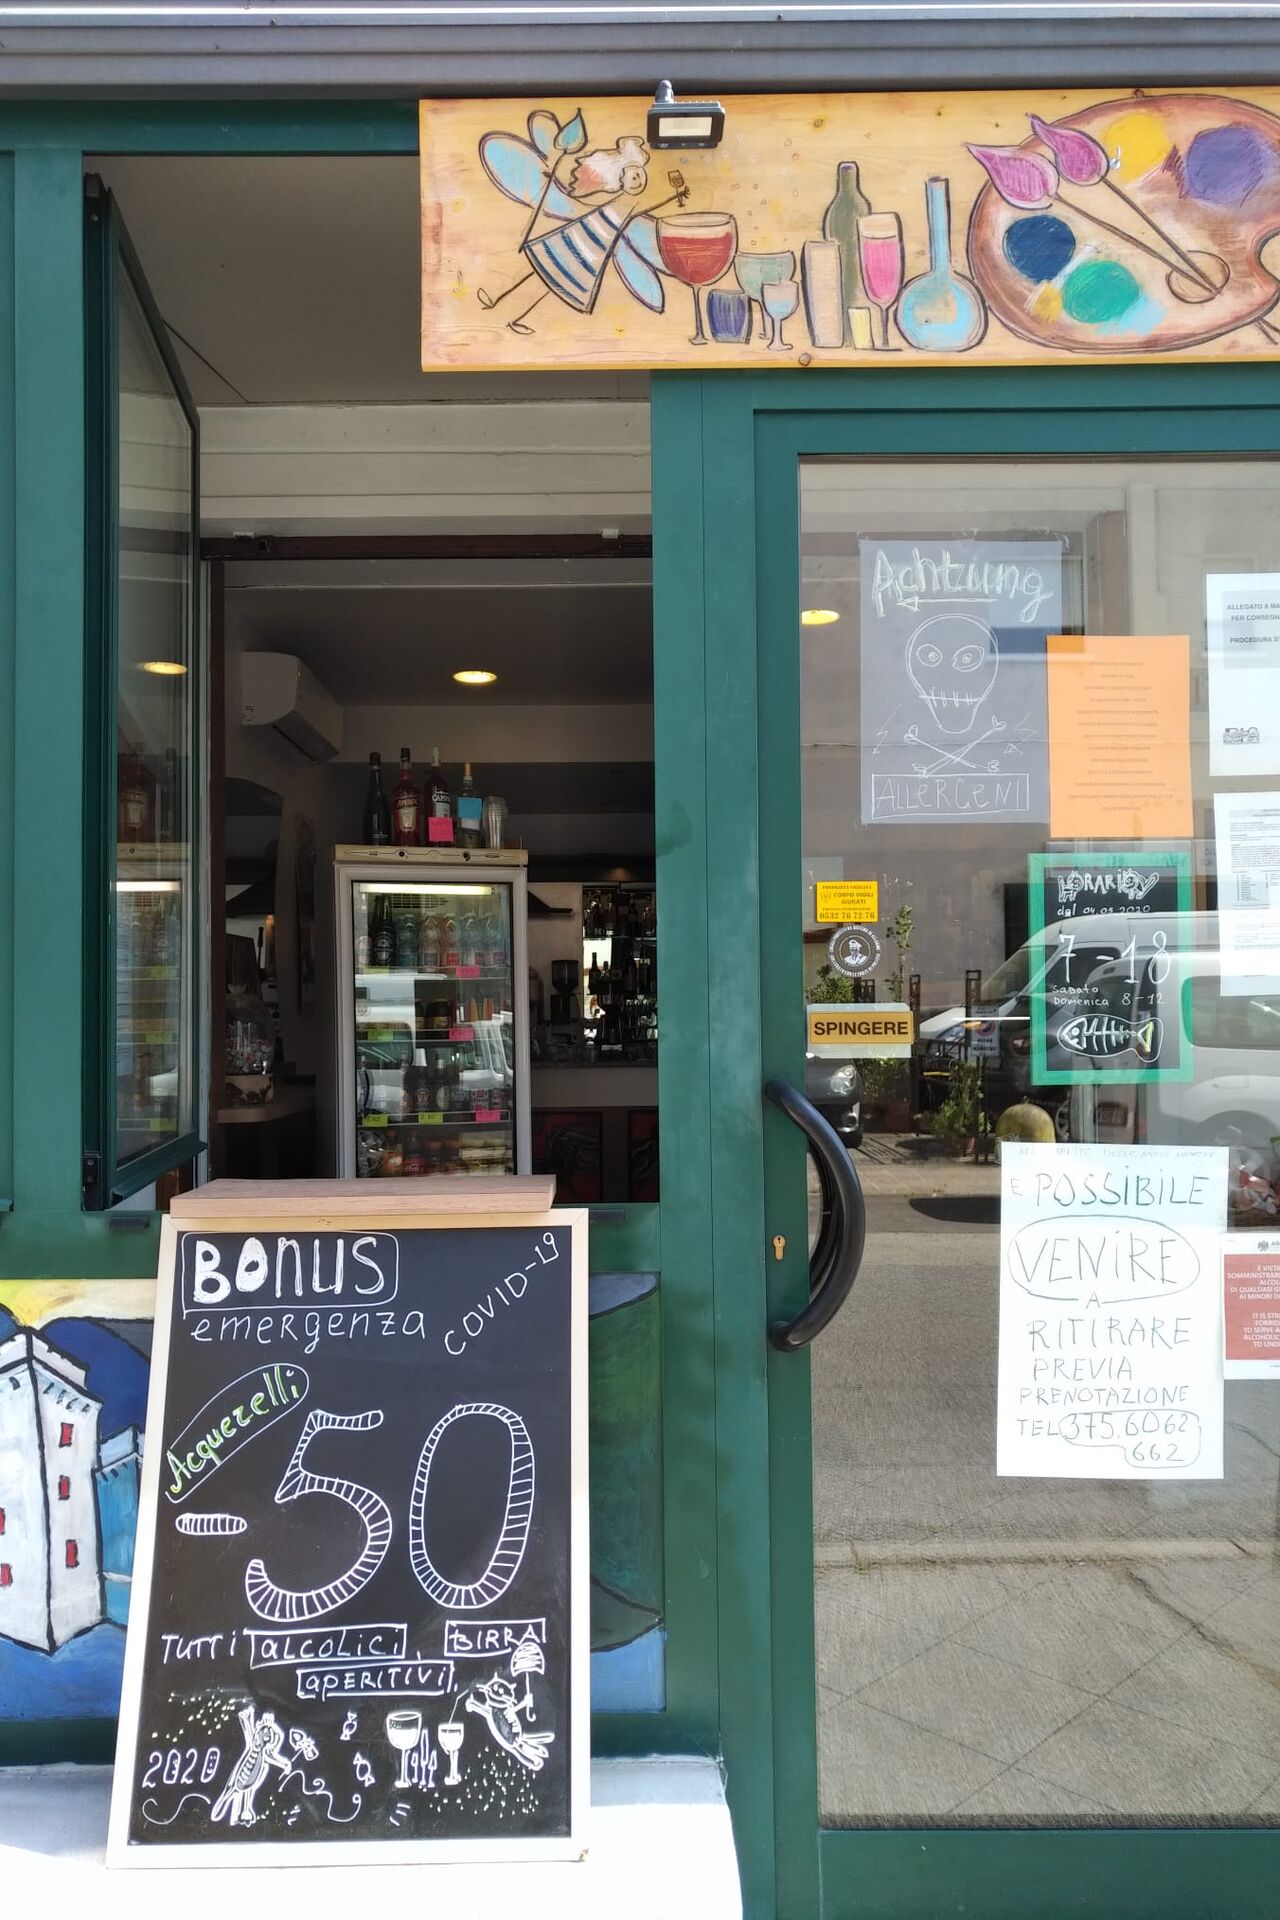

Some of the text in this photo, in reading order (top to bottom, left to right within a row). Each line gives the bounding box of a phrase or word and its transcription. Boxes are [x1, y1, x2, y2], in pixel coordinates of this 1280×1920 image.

[872, 547, 1053, 623] Achtung
[875, 778, 1021, 811] ALLERGENI
[1083, 904, 1151, 916] 04.052020
[814, 1021, 909, 1037] SPINGERE
[1036, 1165, 1211, 1208] POSSIBILE
[193, 1236, 385, 1304] BONUS
[1014, 1230, 1177, 1284] VENIRE
[444, 1231, 560, 1356] COVID-19
[1086, 1293, 1101, 1310] A
[191, 1310, 426, 1354] emergenza
[1027, 1316, 1192, 1352] RITIRARE
[1033, 1356, 1133, 1381] PREVIA
[1019, 1385, 1190, 1406] PRENOTAZIONE
[1017, 1418, 1059, 1437] TEL
[1132, 1443, 1185, 1462] 662
[449, 1623, 544, 1650] BIRRA
[142, 1746, 221, 1788] 2020
